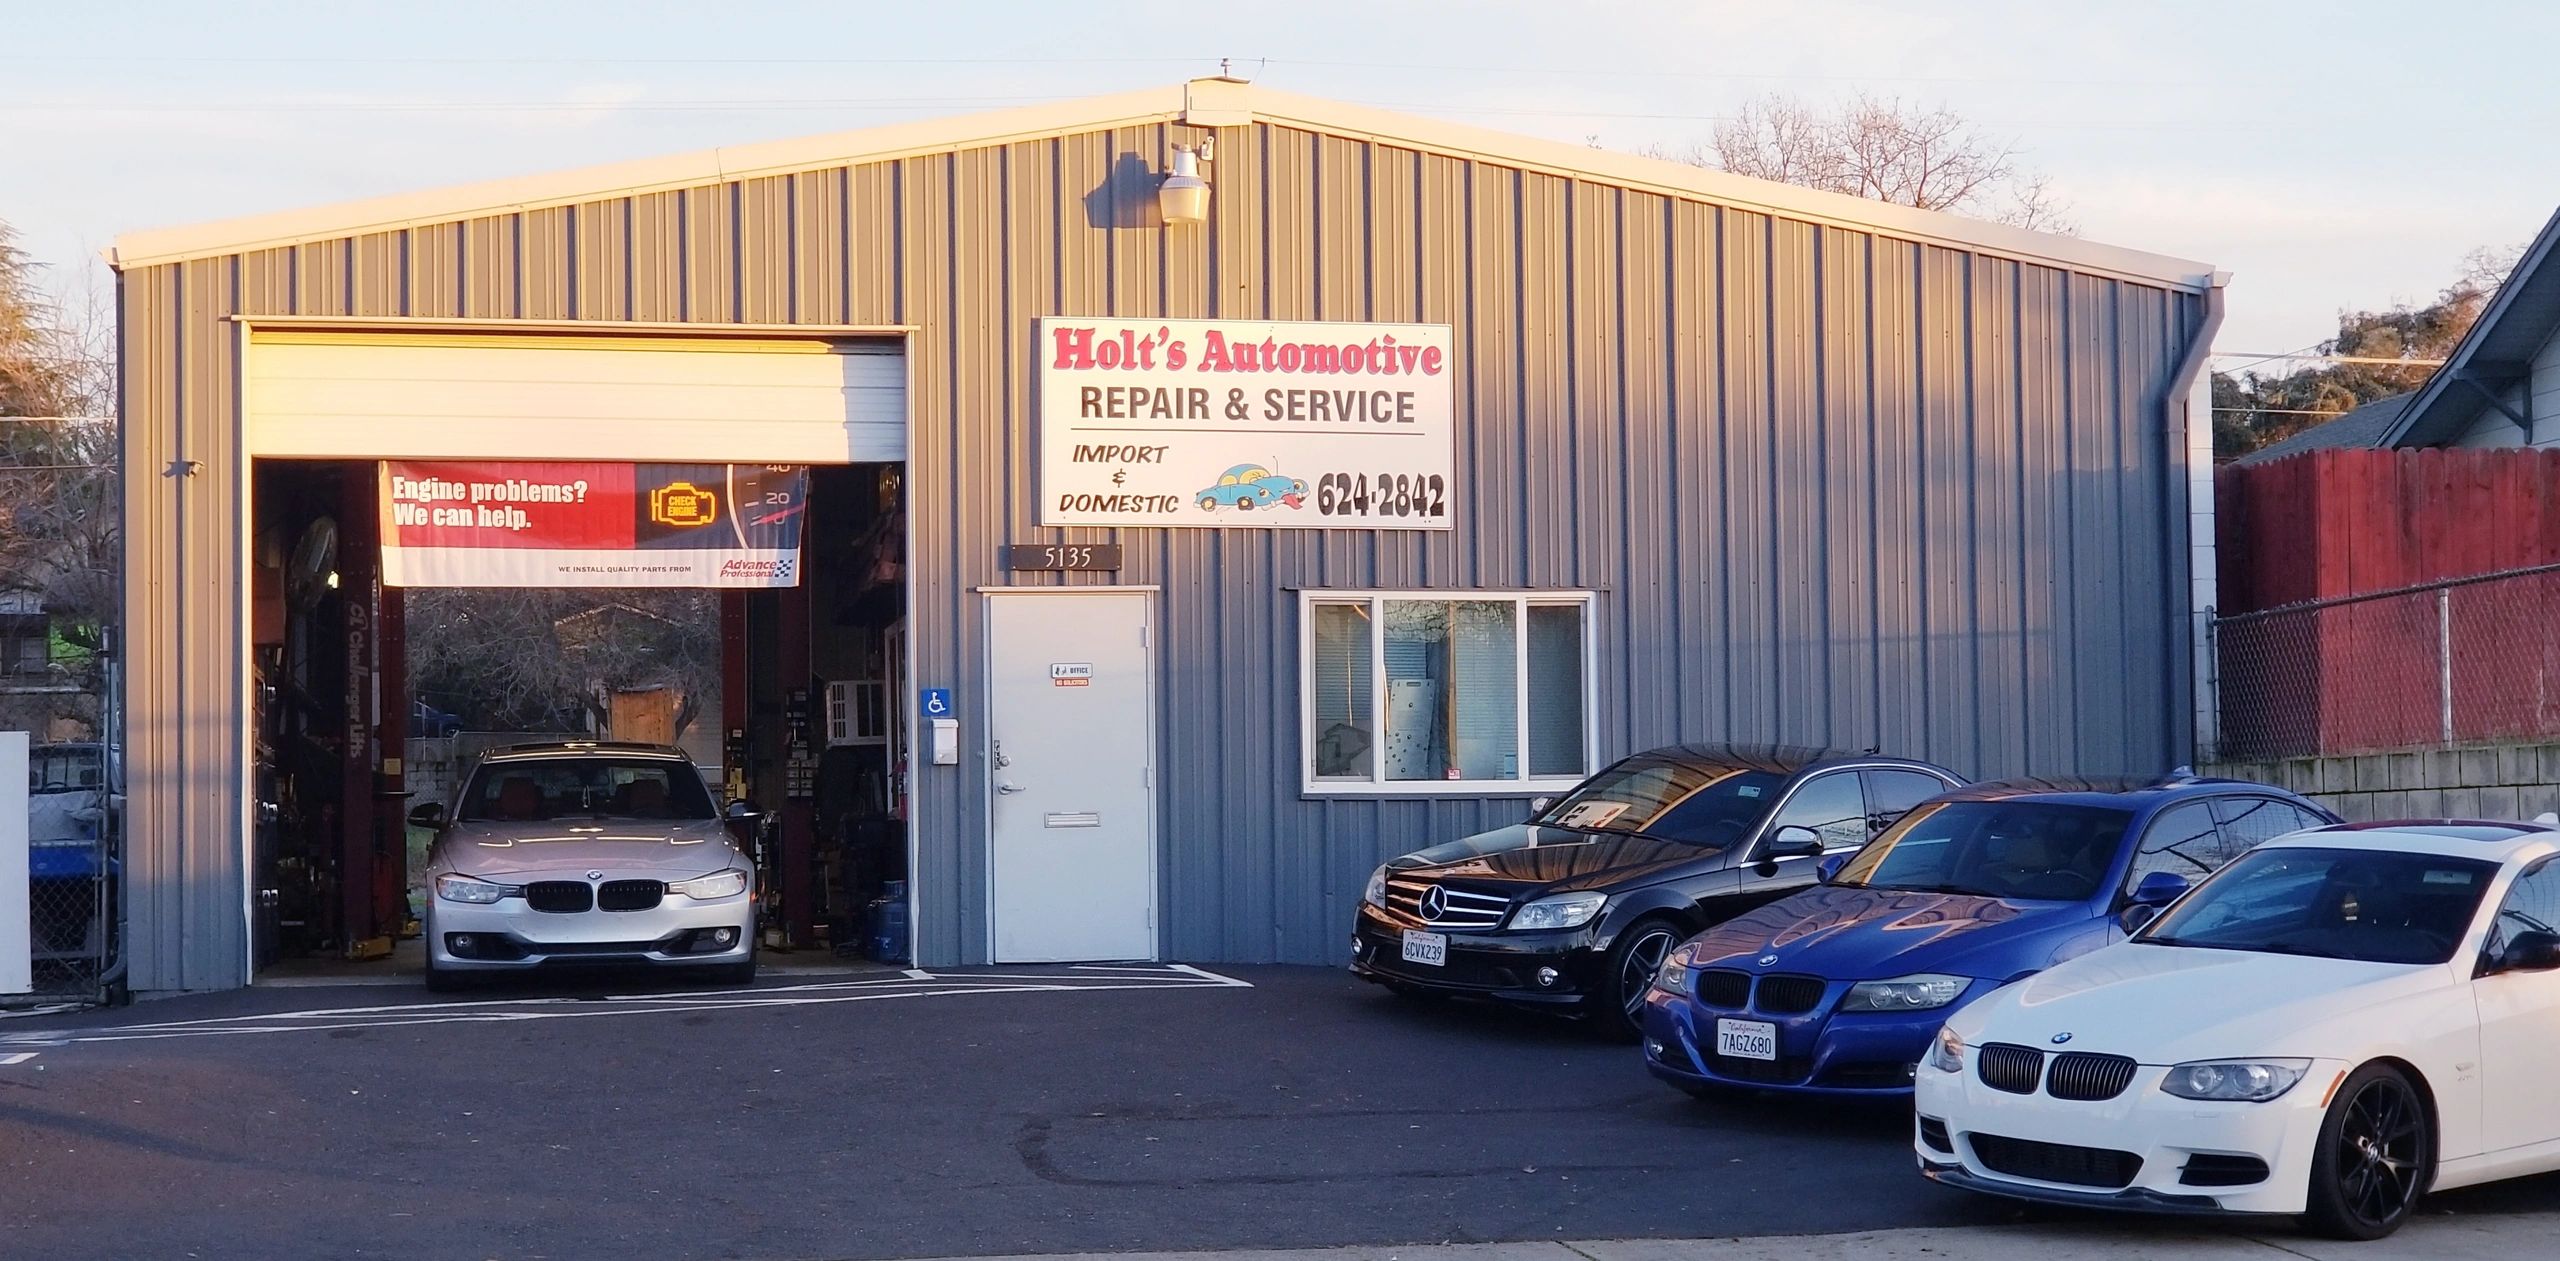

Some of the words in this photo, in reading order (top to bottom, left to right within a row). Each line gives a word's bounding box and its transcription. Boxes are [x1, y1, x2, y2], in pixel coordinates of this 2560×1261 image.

[1053, 326, 1187, 370] Holt's
[1197, 330, 1442, 375] Automotive
[1081, 386, 1210, 420] REPAIR
[1225, 388, 1250, 421] &
[1264, 389, 1415, 423] SERVICE
[1072, 444, 1169, 463] IMPORT
[1112, 468, 1126, 488] &
[392, 476, 466, 503] Engine
[470, 480, 588, 504] problems?
[766, 492, 790, 505] 20
[1317, 472, 1444, 517] 624-2842
[668, 496, 697, 506] CHECK
[1059, 494, 1179, 513] DOMESTIC
[393, 503, 428, 526] We
[432, 506, 474, 527] can
[477, 504, 532, 531] help.
[667, 506, 697, 517] ENGINE
[723, 559, 777, 570] Advance
[1045, 547, 1091, 568] 5135
[607, 566, 639, 574] QUALITY
[720, 569, 775, 578] Professional
[345, 631, 368, 722] Challenger
[350, 723, 364, 758] Lifts
[1405, 942, 1442, 961] 6CVX239
[1722, 1033, 1772, 1054] 7AGZ680
